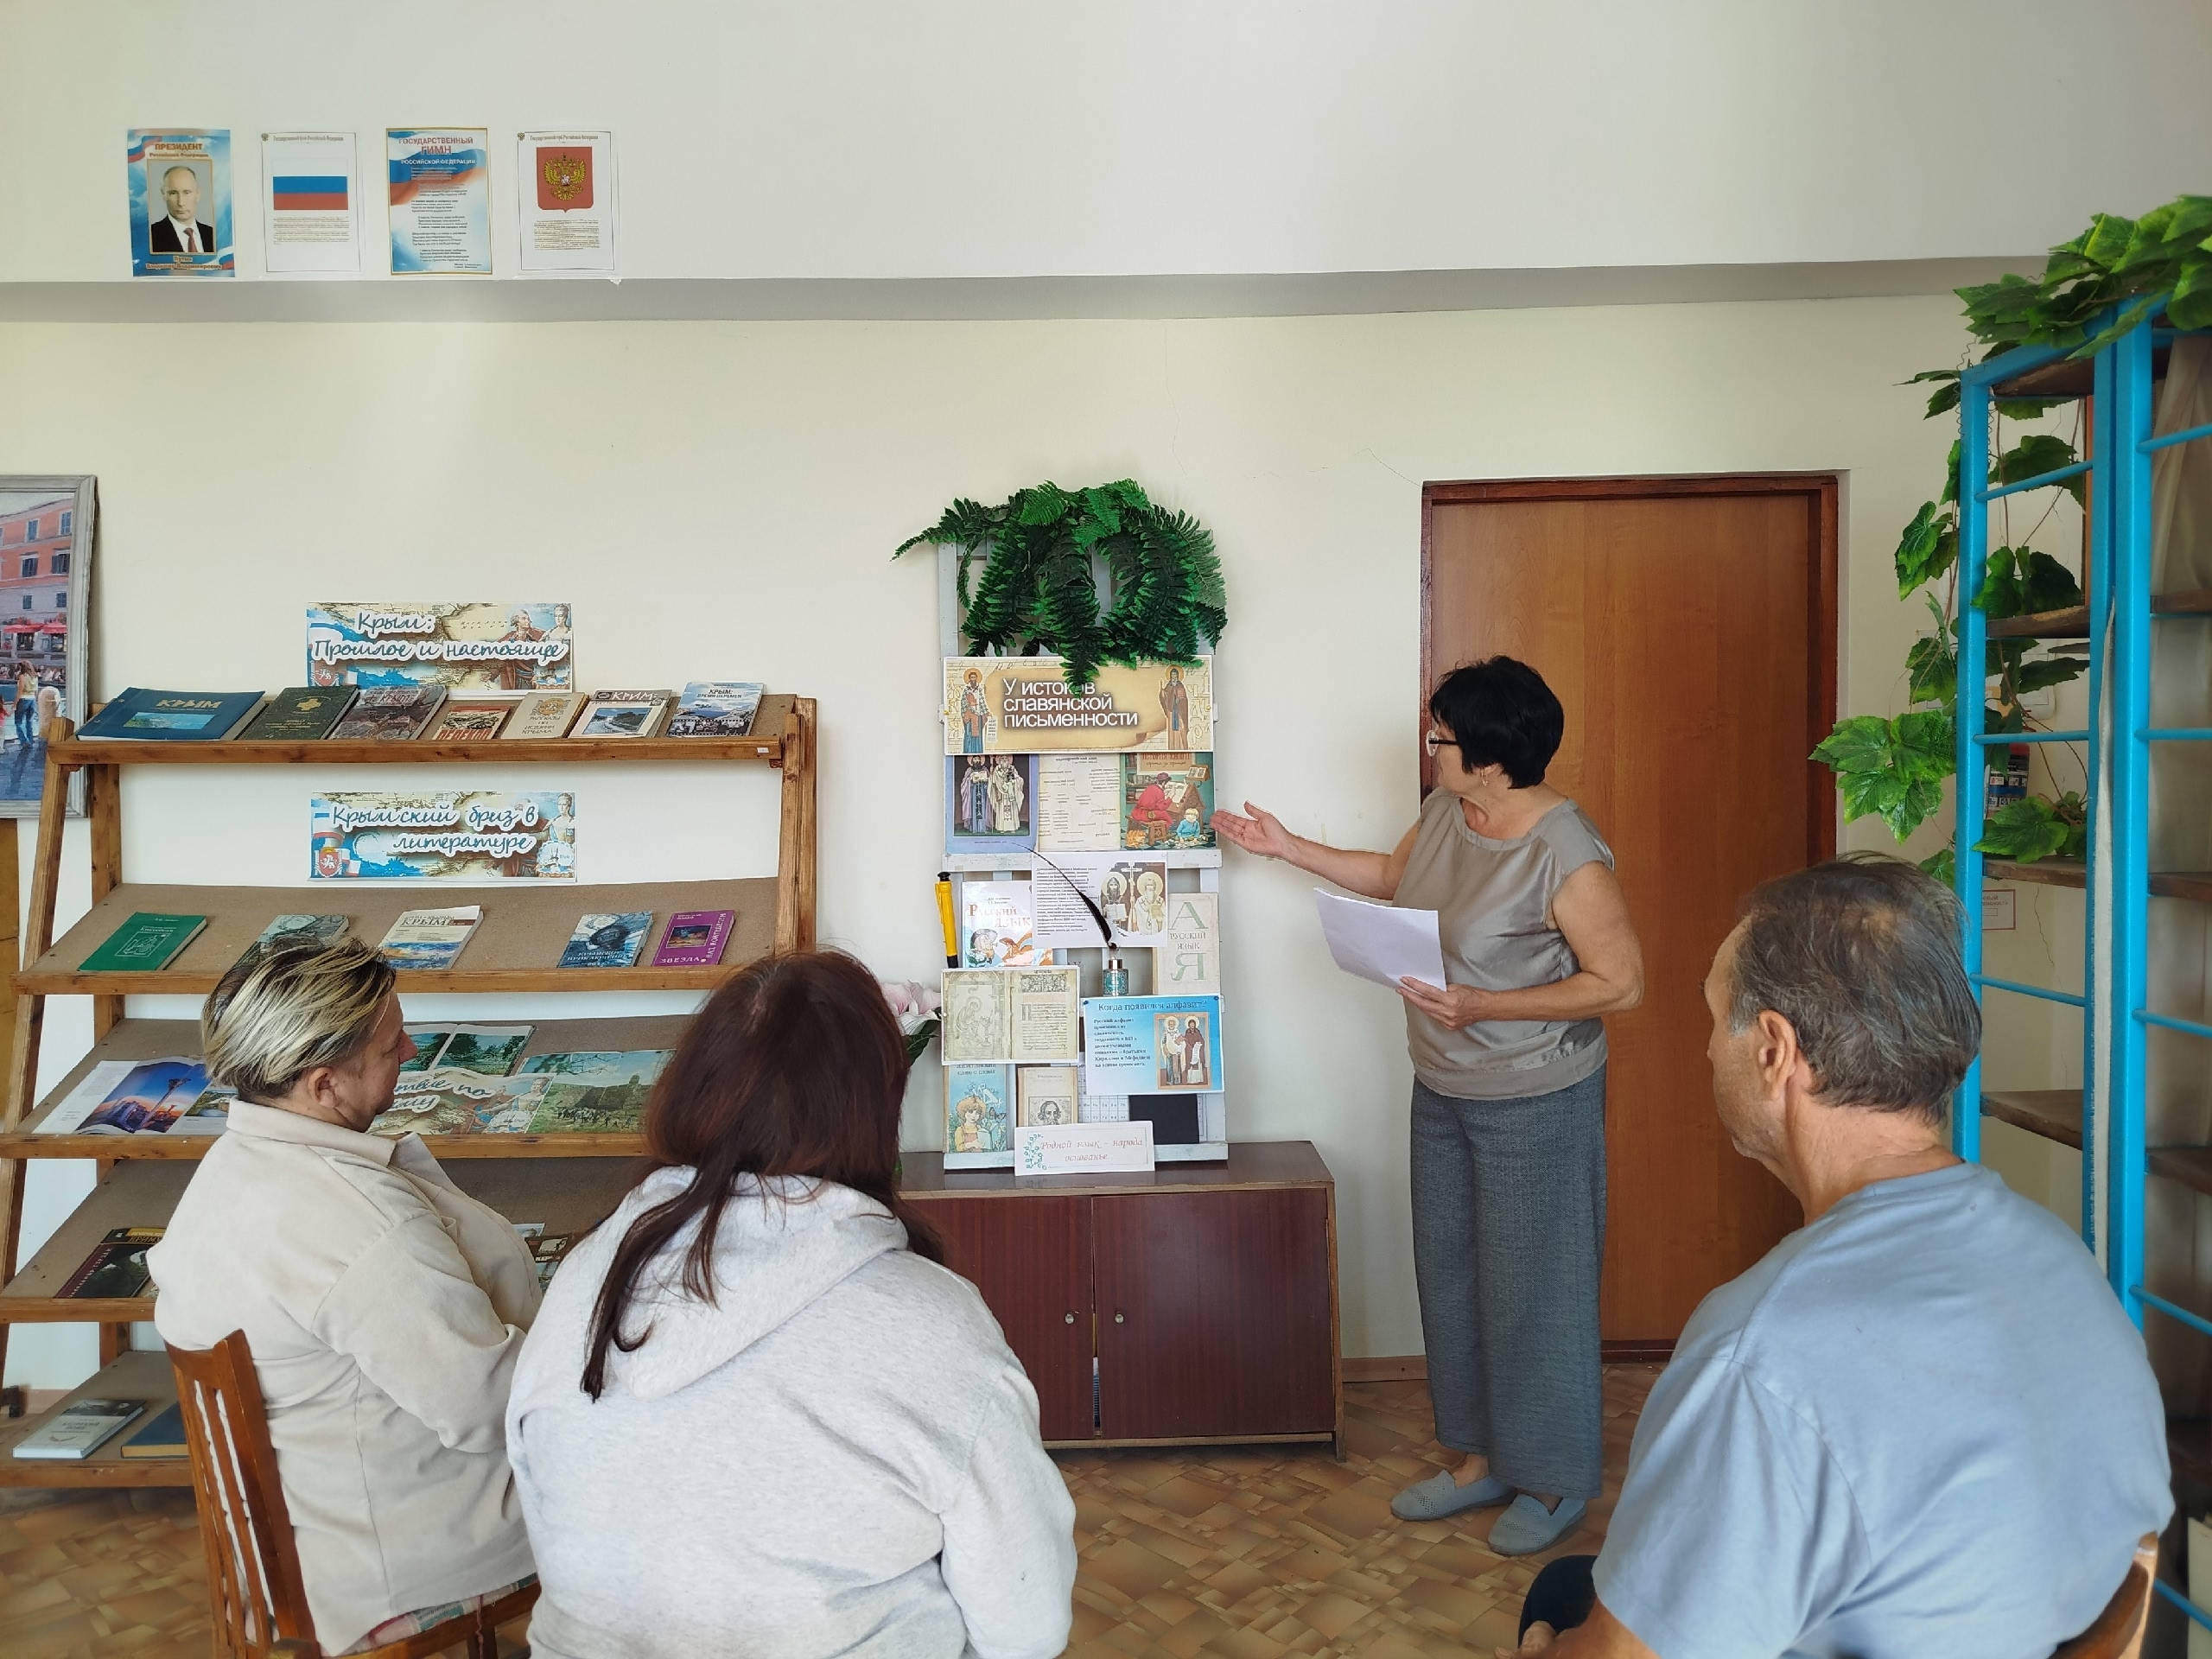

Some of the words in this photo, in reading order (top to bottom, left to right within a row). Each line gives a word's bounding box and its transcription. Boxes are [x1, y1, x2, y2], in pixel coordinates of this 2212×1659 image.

[421, 145, 453, 155] ГИМН
[358, 612, 433, 634] Крым:
[315, 639, 413, 662] Прошлое
[418, 645, 440, 657] и
[447, 642, 565, 663] настоящее
[1002, 677, 1018, 696] У
[1021, 681, 1096, 696] истокв
[156, 699, 223, 709] КРЫМ
[1003, 694, 1113, 712] славянской
[1004, 711, 1138, 728] письменности
[333, 805, 458, 829] Крымский
[467, 804, 518, 829] бриз
[525, 804, 538, 823] в
[393, 834, 535, 855] литературе
[995, 917, 1031, 928] ЯЗЫК
[1171, 952, 1207, 982] Я
[1098, 1002, 1123, 1012] Когда
[1125, 1002, 1163, 1011] появился
[1166, 1000, 1207, 1011] алфавит?
[457, 1084, 492, 1096] по
[1040, 1140, 1072, 1150] Родной
[1113, 1137, 1143, 1149] народа
